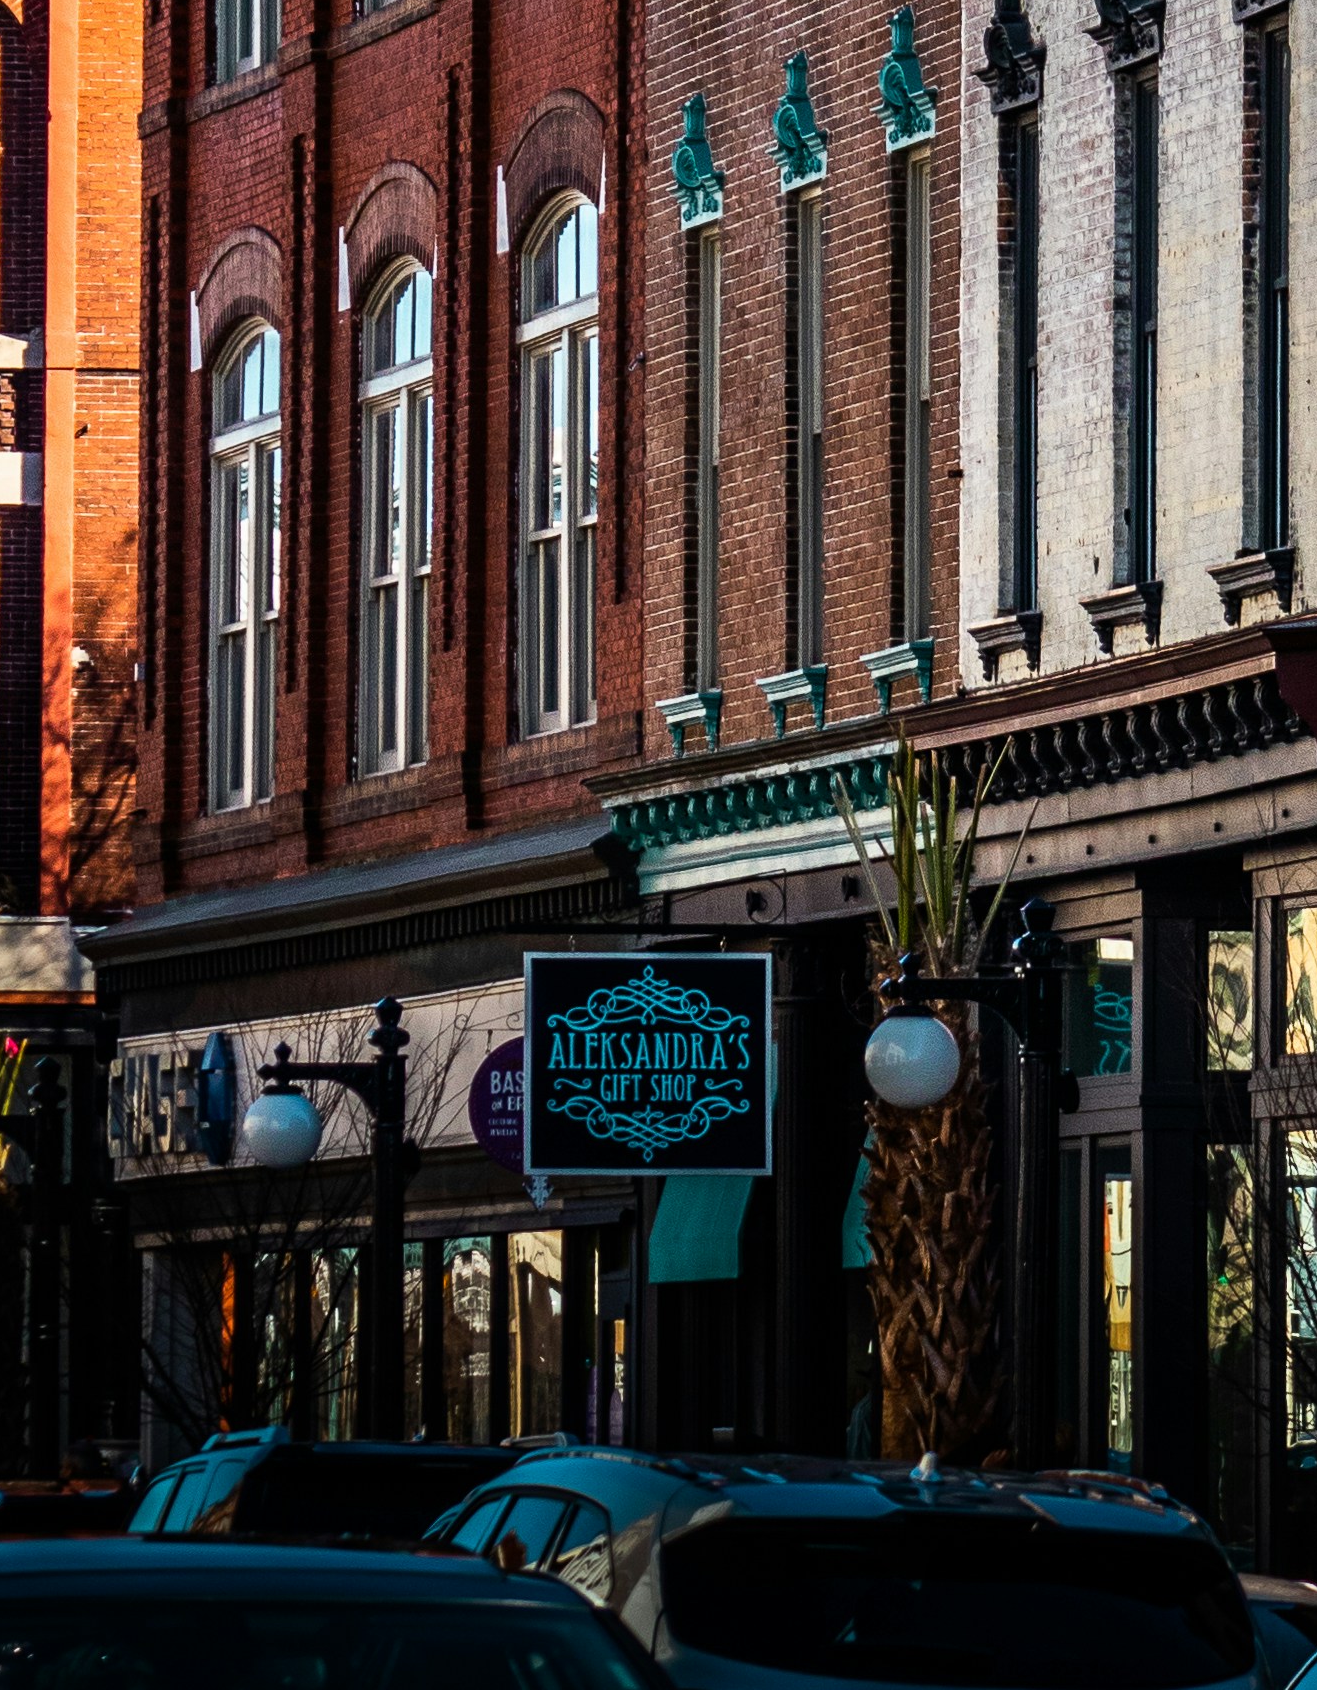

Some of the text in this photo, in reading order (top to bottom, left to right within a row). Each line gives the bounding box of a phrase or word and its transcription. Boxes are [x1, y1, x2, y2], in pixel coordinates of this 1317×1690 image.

[547, 1032, 751, 1070] ALEKSANDRA'S
[599, 1073, 697, 1102] GIFT SHOP
